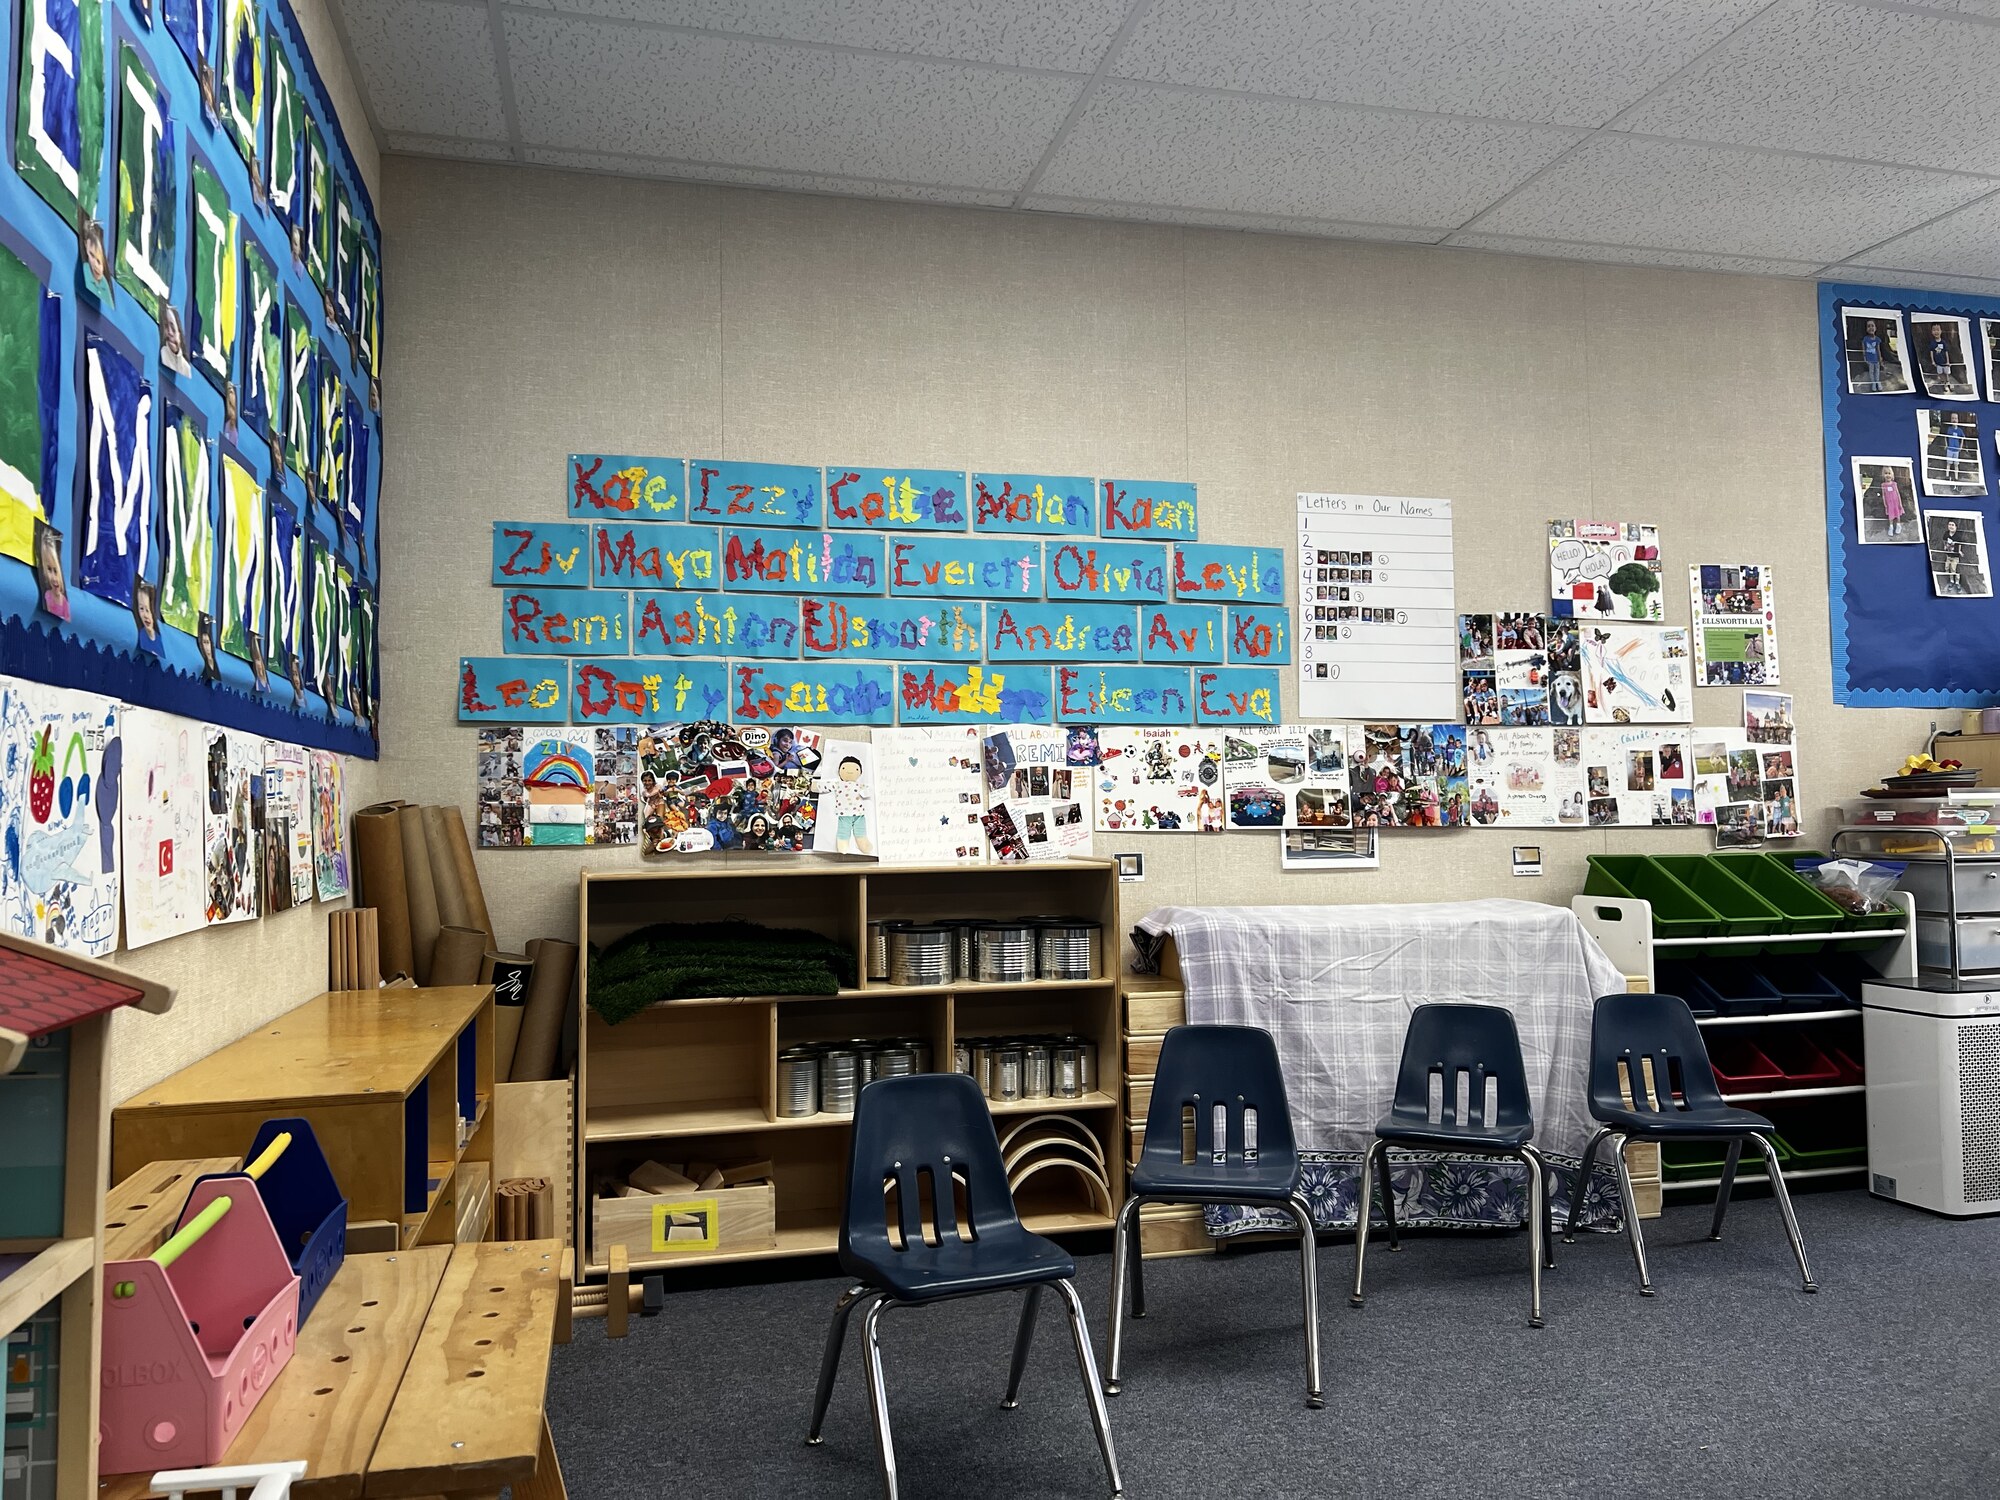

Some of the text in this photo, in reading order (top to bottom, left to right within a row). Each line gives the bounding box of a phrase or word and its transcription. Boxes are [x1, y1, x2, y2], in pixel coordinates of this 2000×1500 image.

[290, 327, 310, 467] K
[86, 348, 151, 577] M
[574, 458, 678, 513] Kate
[694, 468, 815, 524] Izzy
[1105, 482, 1195, 533] Kaan
[1305, 496, 1433, 517] Letters in Our Names
[166, 425, 210, 613] M
[1303, 517, 1309, 530] 1
[1303, 534, 1313, 549] 2
[1304, 552, 1314, 566] 3
[1556, 547, 1581, 562] HELLO!
[500, 528, 1281, 598] Ziv Maya Matilda Everett Olivia Leyla
[1585, 559, 1607, 573] HOLA!
[1303, 569, 1312, 584] 4
[1305, 587, 1314, 603] 5
[1305, 608, 1313, 622] 6
[1702, 617, 1748, 625] ELLSWORTH
[507, 594, 622, 646] Remi
[638, 596, 798, 649] Ashton
[994, 608, 1133, 653] Andrea
[1148, 613, 1214, 654] Avi
[1234, 614, 1284, 658] Kai
[1303, 627, 1312, 642] 7
[1305, 646, 1313, 659] 8
[1304, 664, 1313, 680] 9
[462, 663, 560, 712] Leo
[579, 664, 724, 720] Dotty
[735, 666, 892, 719] Isaiah
[1059, 667, 1186, 716] Eileen
[1199, 673, 1272, 723] Eva
[745, 733, 766, 741] Dino
[1008, 729, 1061, 740] ALL ABOUT
[1143, 729, 1171, 737] Isaiah
[1239, 725, 1307, 735] ALL ABOUT IZZY
[1498, 732, 1509, 740] All
[541, 741, 575, 755] ZIV
[1016, 743, 1066, 763] REMI
